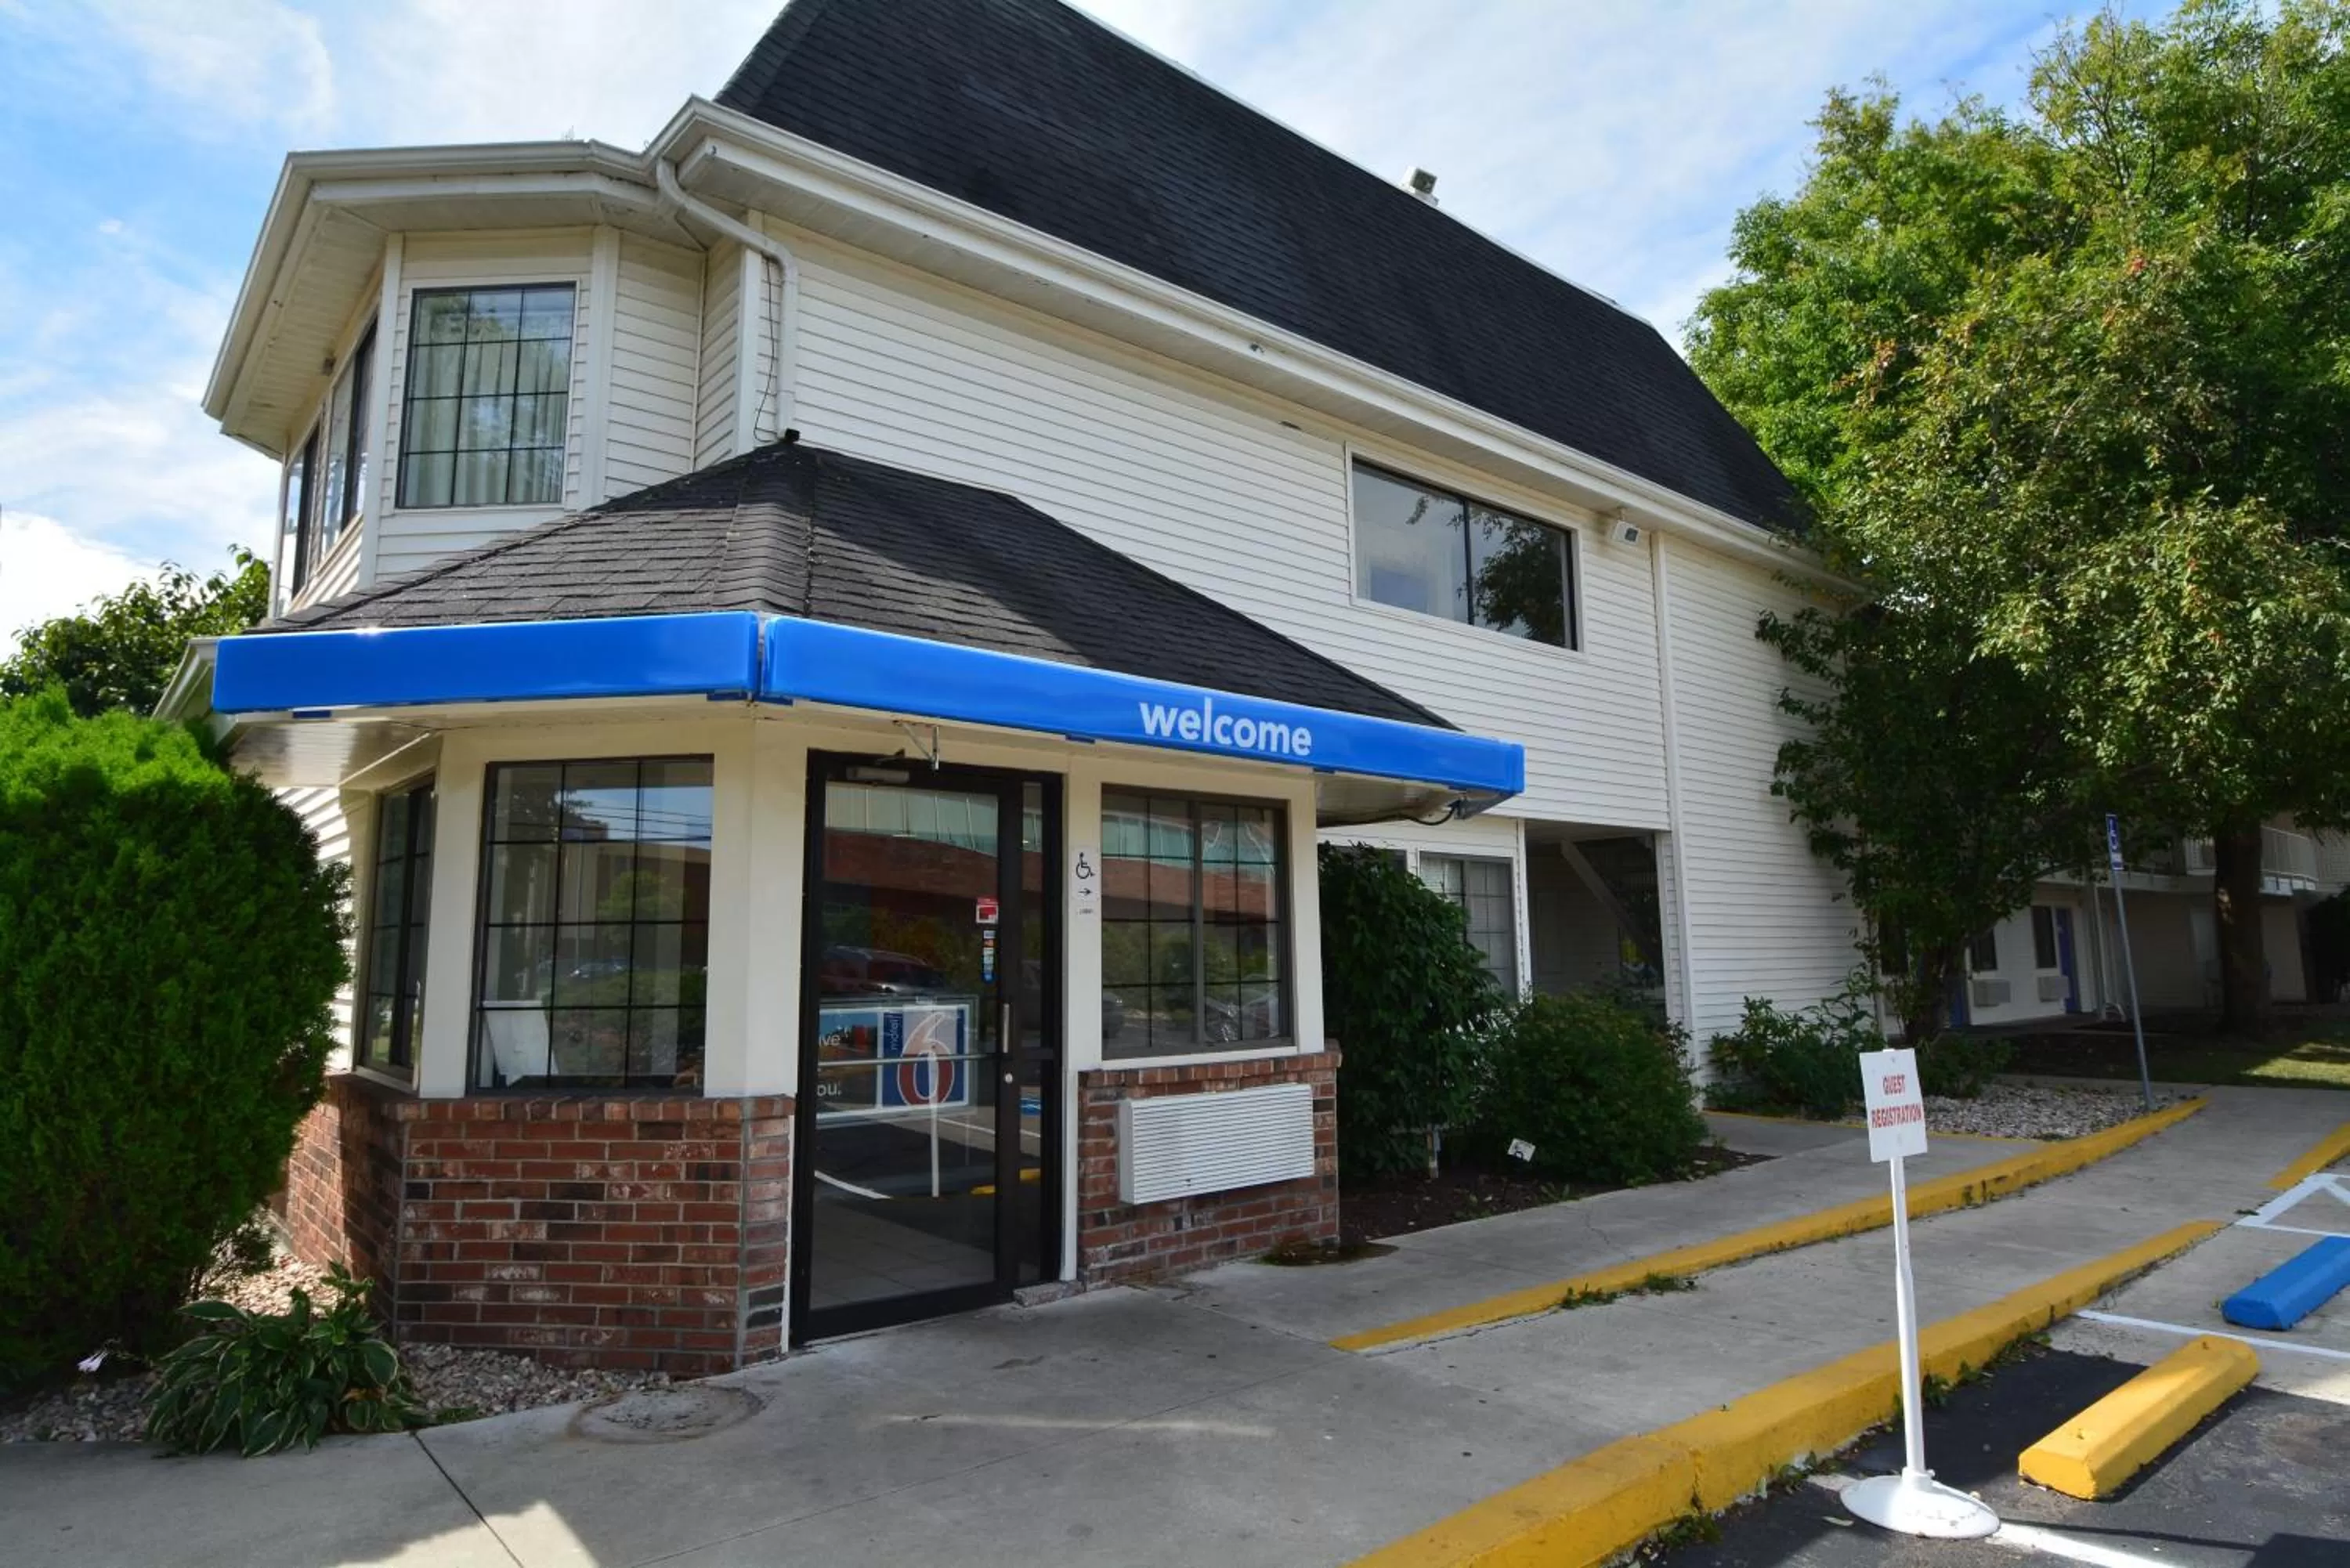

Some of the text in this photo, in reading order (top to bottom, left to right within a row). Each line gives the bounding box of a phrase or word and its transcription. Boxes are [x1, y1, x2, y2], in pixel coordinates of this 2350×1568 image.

[1139, 697, 1312, 757] welcome
[897, 1011, 955, 1107] 6
[1883, 1075, 1905, 1095] GUEST
[1871, 1104, 1922, 1128] REGISTRATION
